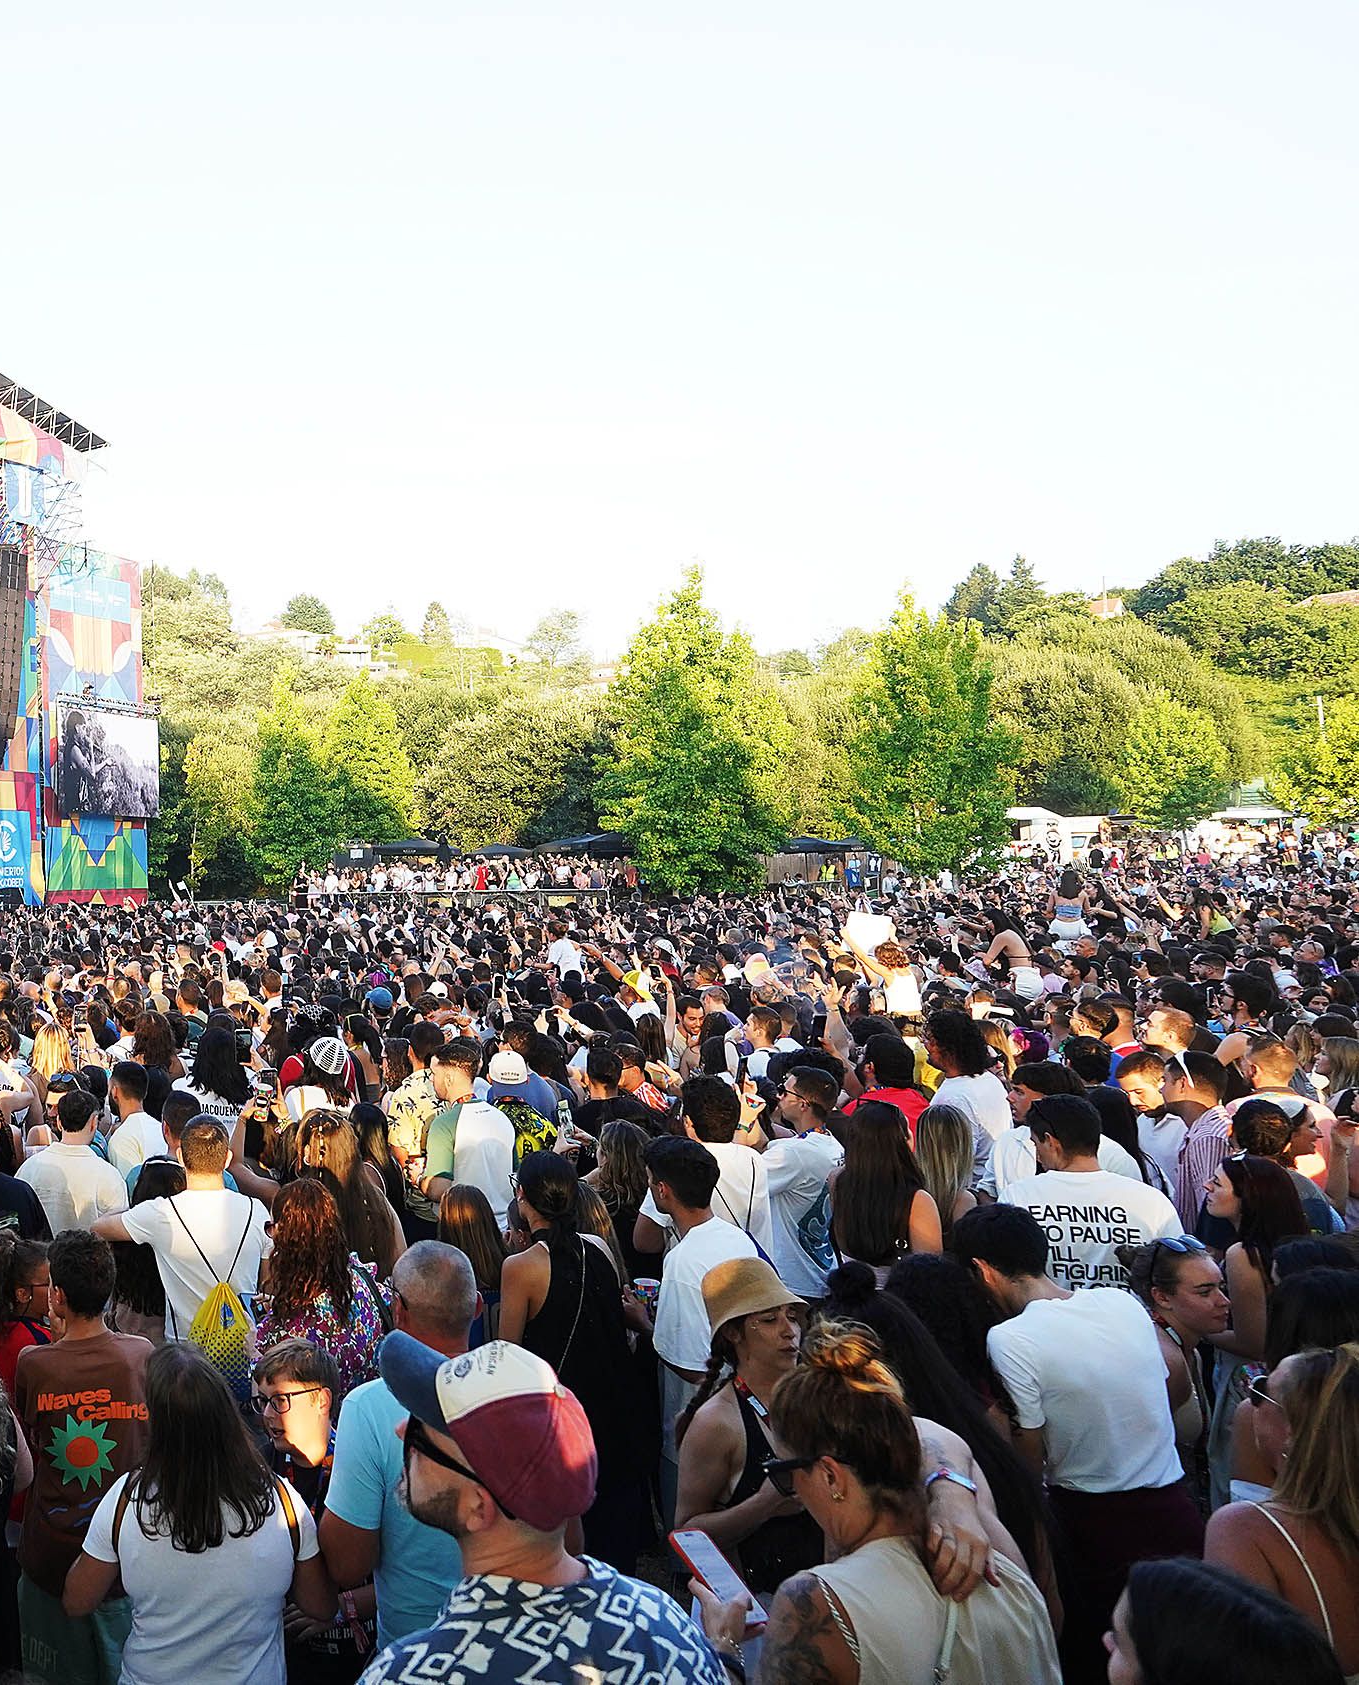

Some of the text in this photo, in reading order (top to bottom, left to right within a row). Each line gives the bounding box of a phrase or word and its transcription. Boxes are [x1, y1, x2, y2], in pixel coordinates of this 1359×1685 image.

[1028, 1204, 1128, 1224] EARNING
[1052, 1263, 1131, 1281] FIGURIN
[37, 1388, 112, 1412] Waves
[76, 1401, 150, 1421] Calling
